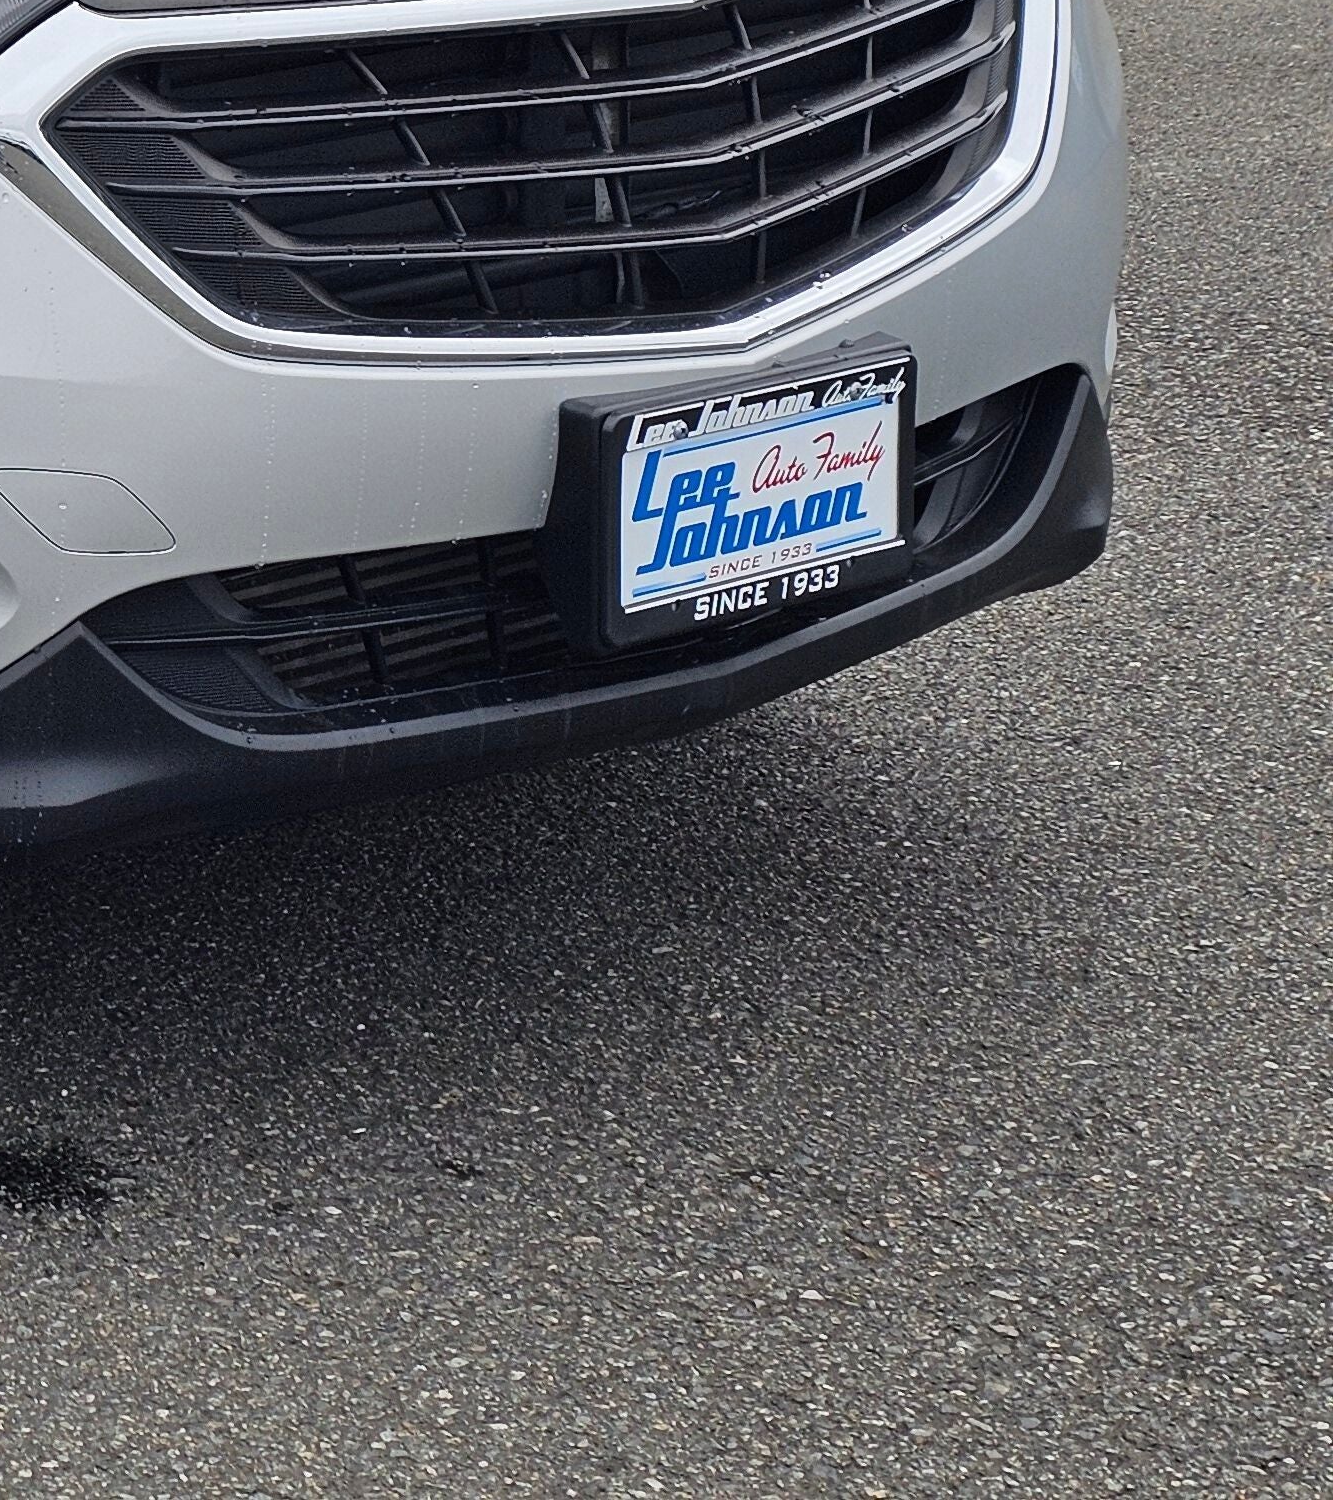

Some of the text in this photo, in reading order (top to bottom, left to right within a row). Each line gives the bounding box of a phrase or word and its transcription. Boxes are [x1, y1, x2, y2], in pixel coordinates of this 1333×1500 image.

[687, 391, 815, 438] Johnson
[858, 367, 906, 403] Family
[632, 420, 885, 522] Lee Auto Family
[636, 481, 867, 576] Johnson
[708, 543, 813, 579] SINCE 1933
[693, 565, 840, 621] SINCE 1933
